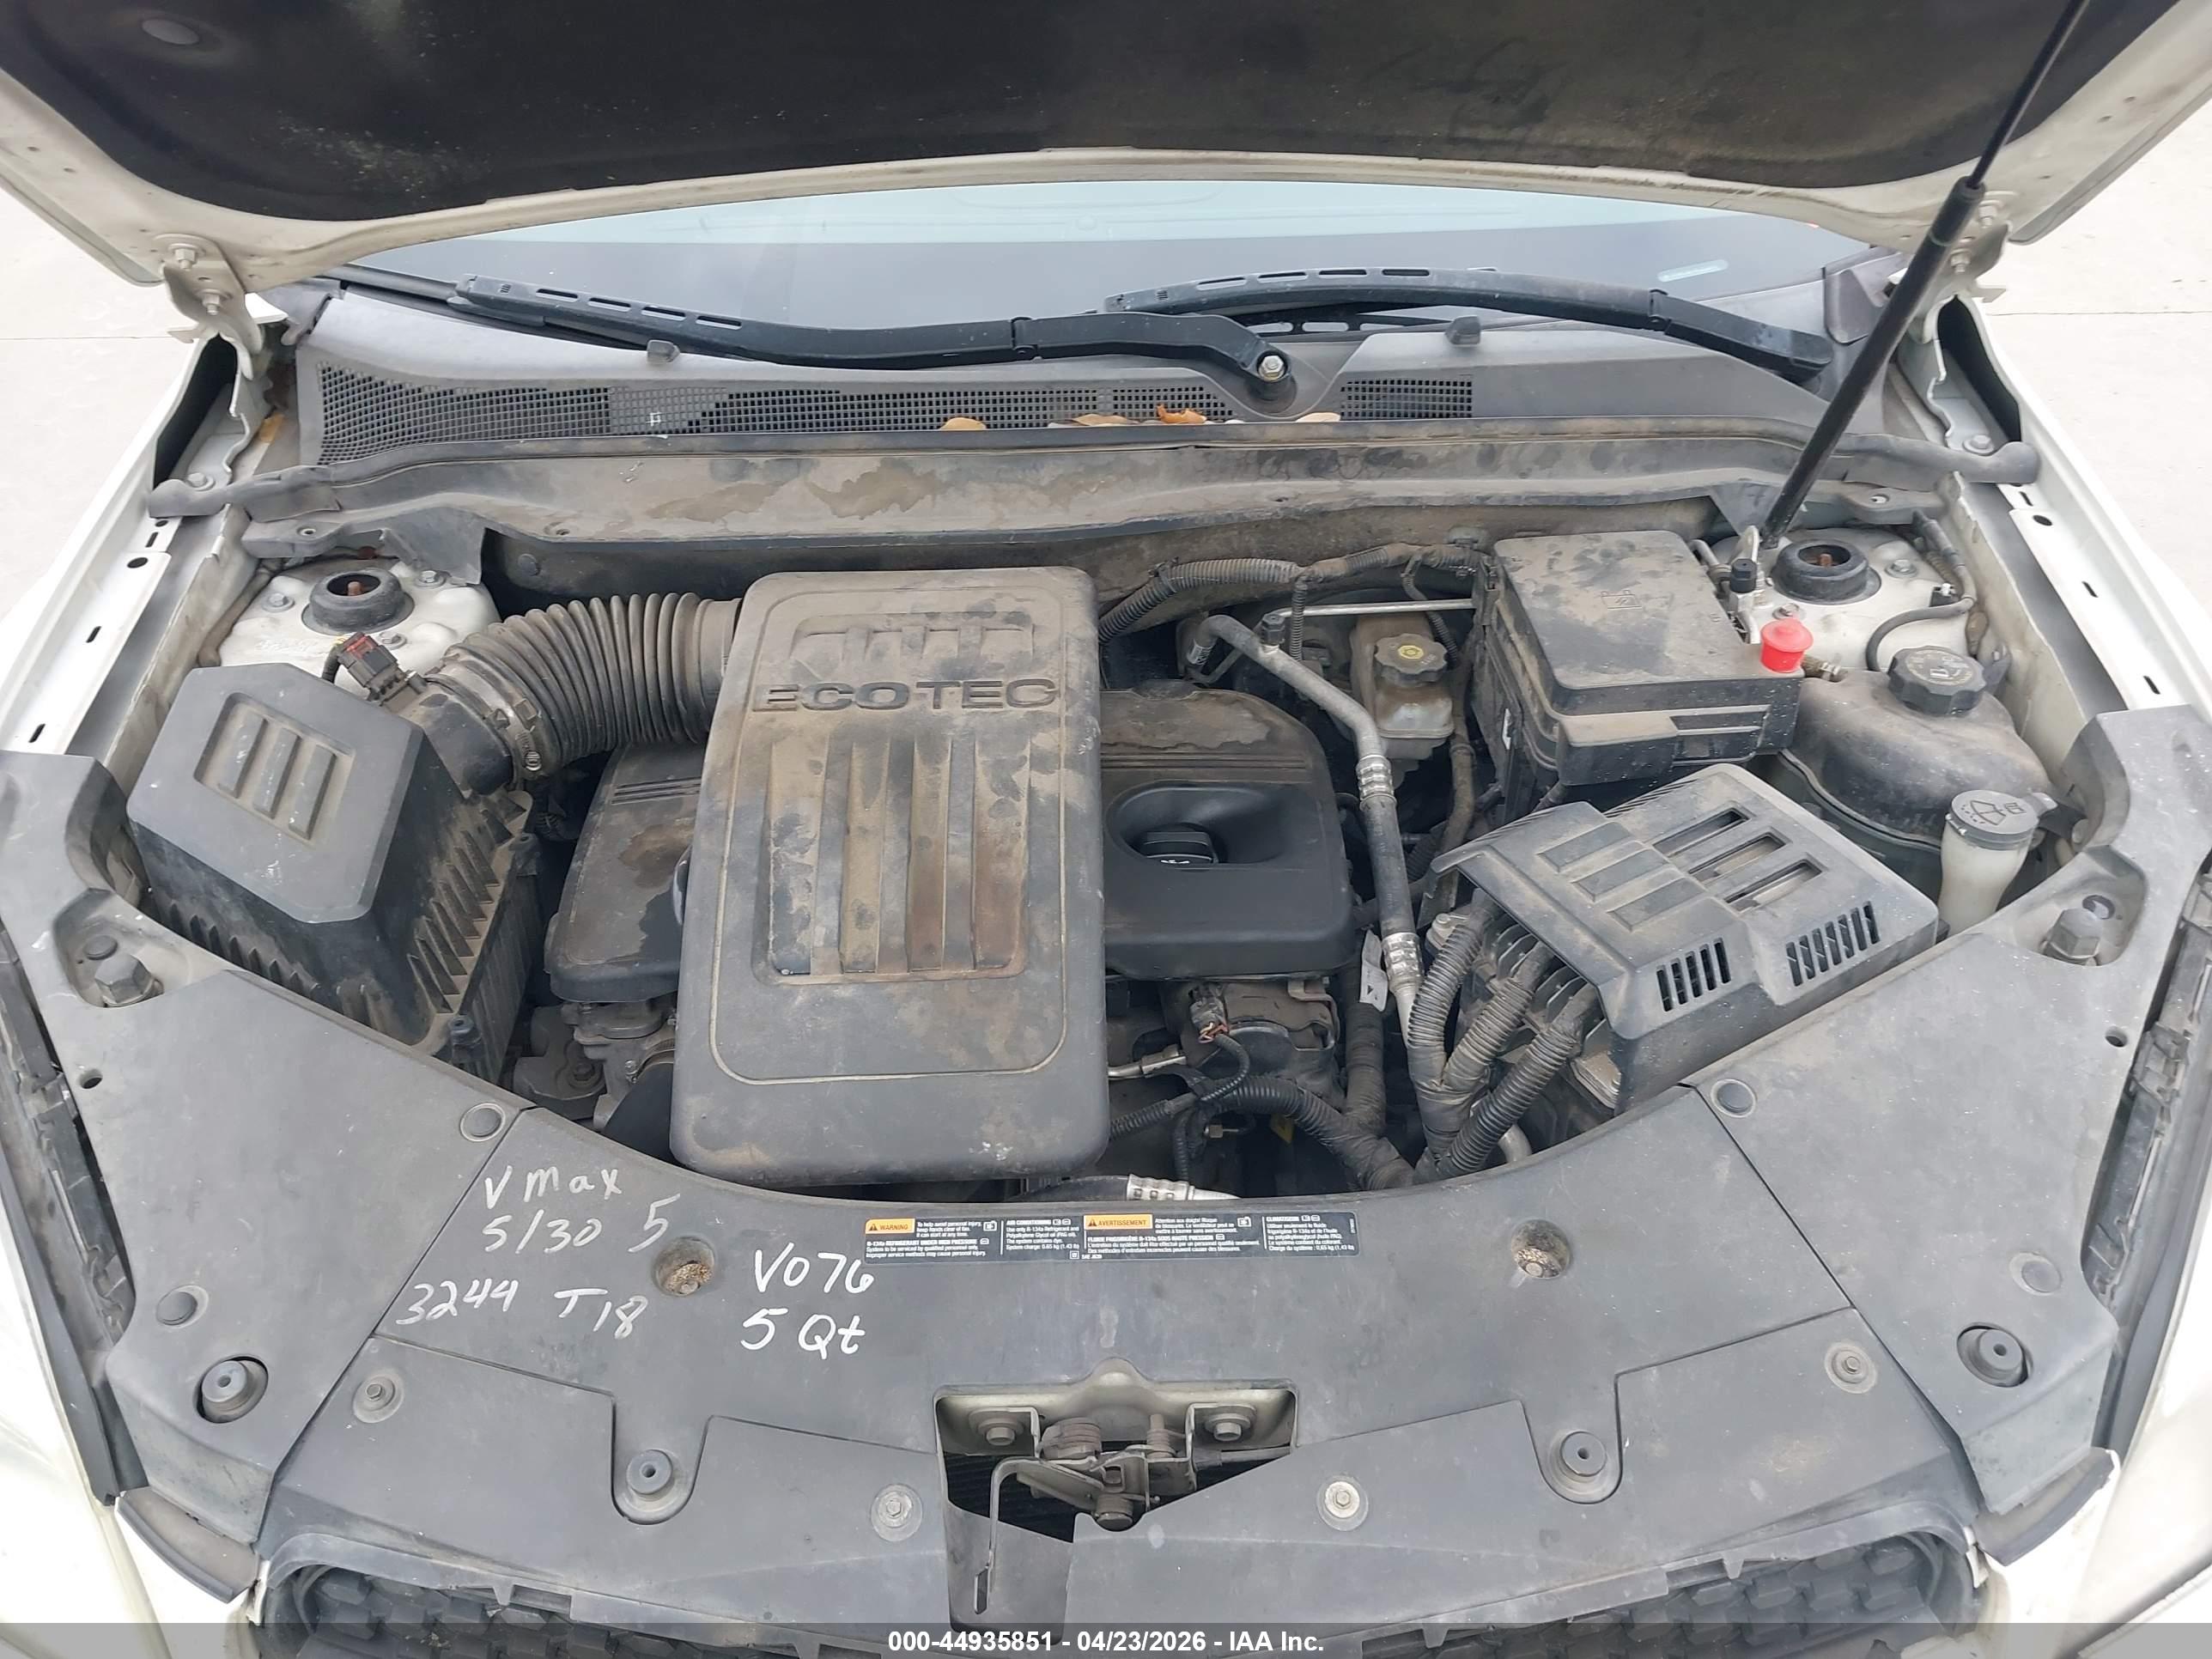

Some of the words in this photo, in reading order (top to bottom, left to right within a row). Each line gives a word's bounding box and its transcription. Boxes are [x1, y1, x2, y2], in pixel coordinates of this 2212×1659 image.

[752, 678, 1060, 712] ECOTEC
[740, 1308, 788, 1351] 5
[798, 1314, 866, 1360] Qt
